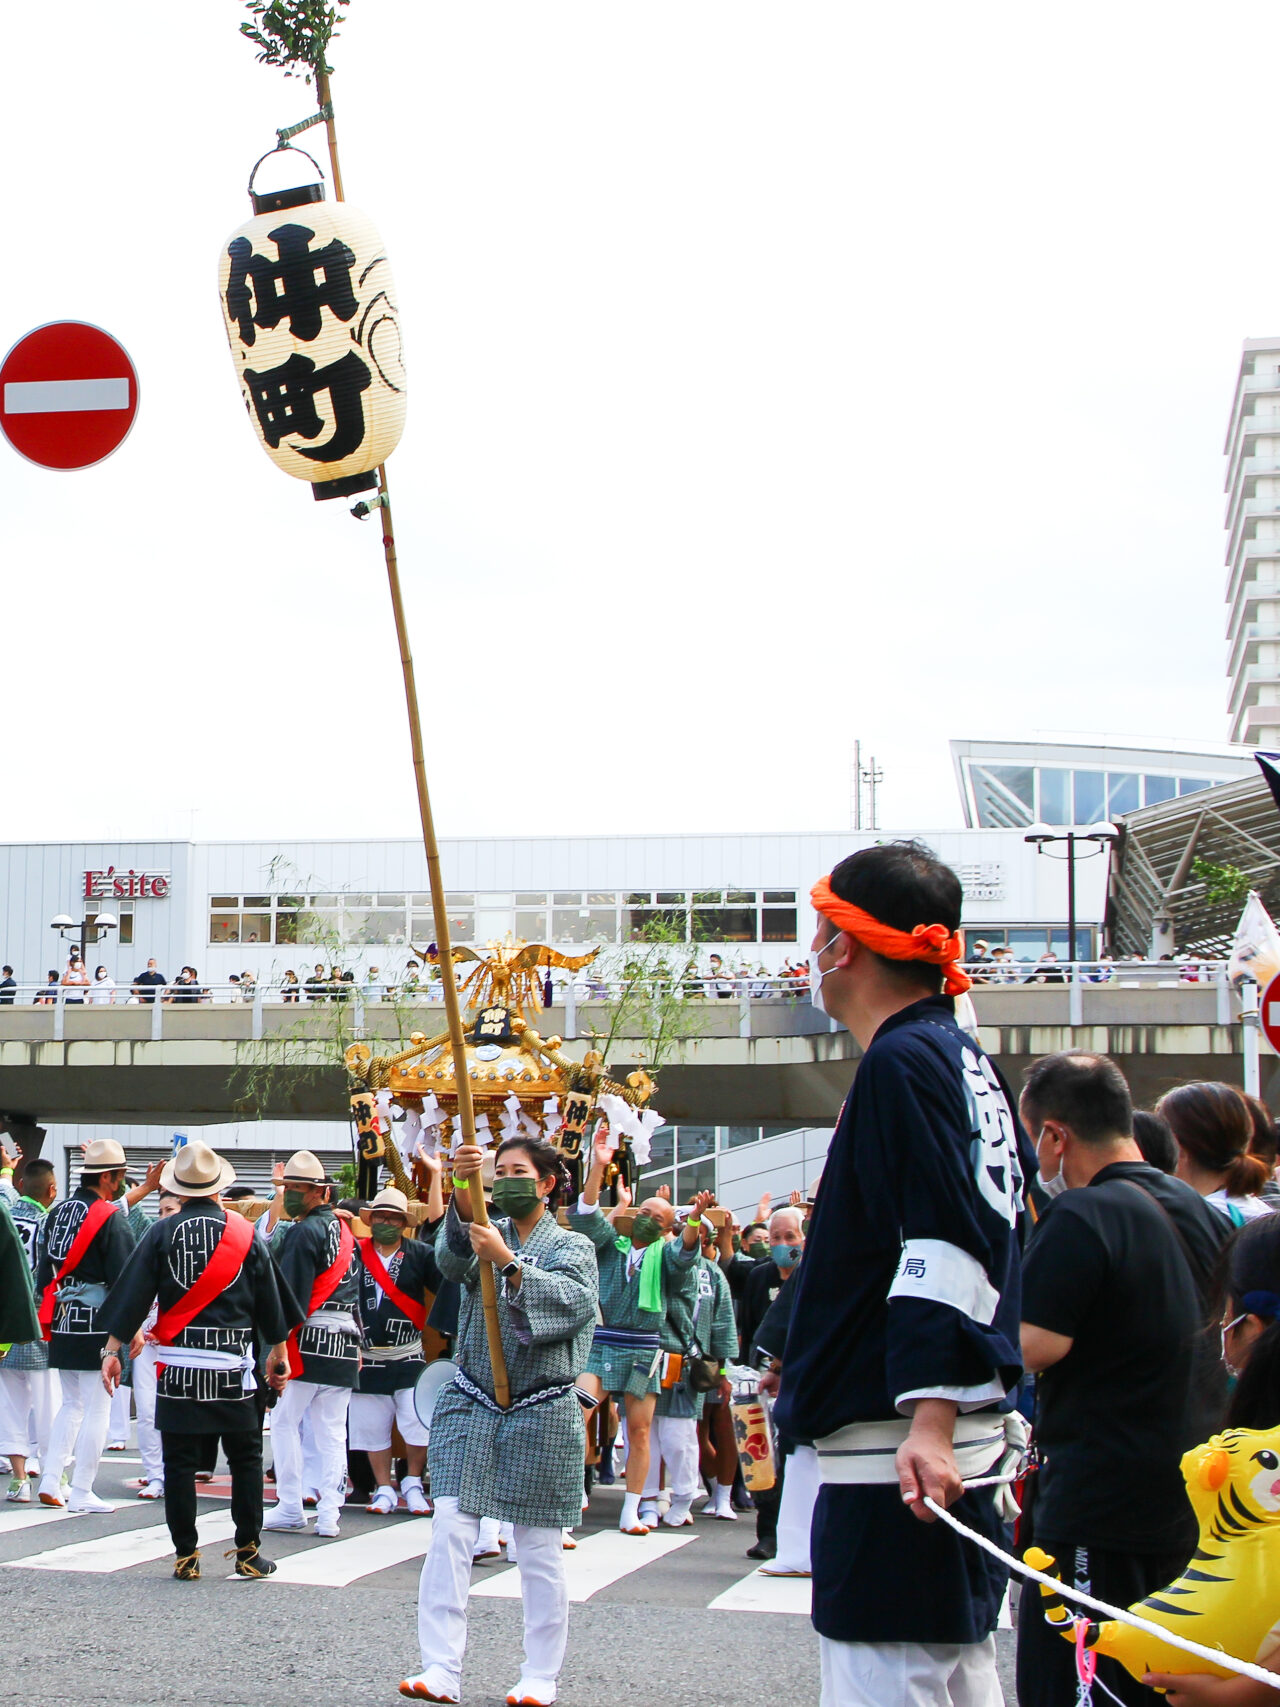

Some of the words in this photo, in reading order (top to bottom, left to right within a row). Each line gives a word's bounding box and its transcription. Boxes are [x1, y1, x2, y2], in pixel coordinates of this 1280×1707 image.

[226, 224, 372, 463] 仲町
[85, 866, 168, 897] E'site
[560, 1100, 589, 1154] 仲町
